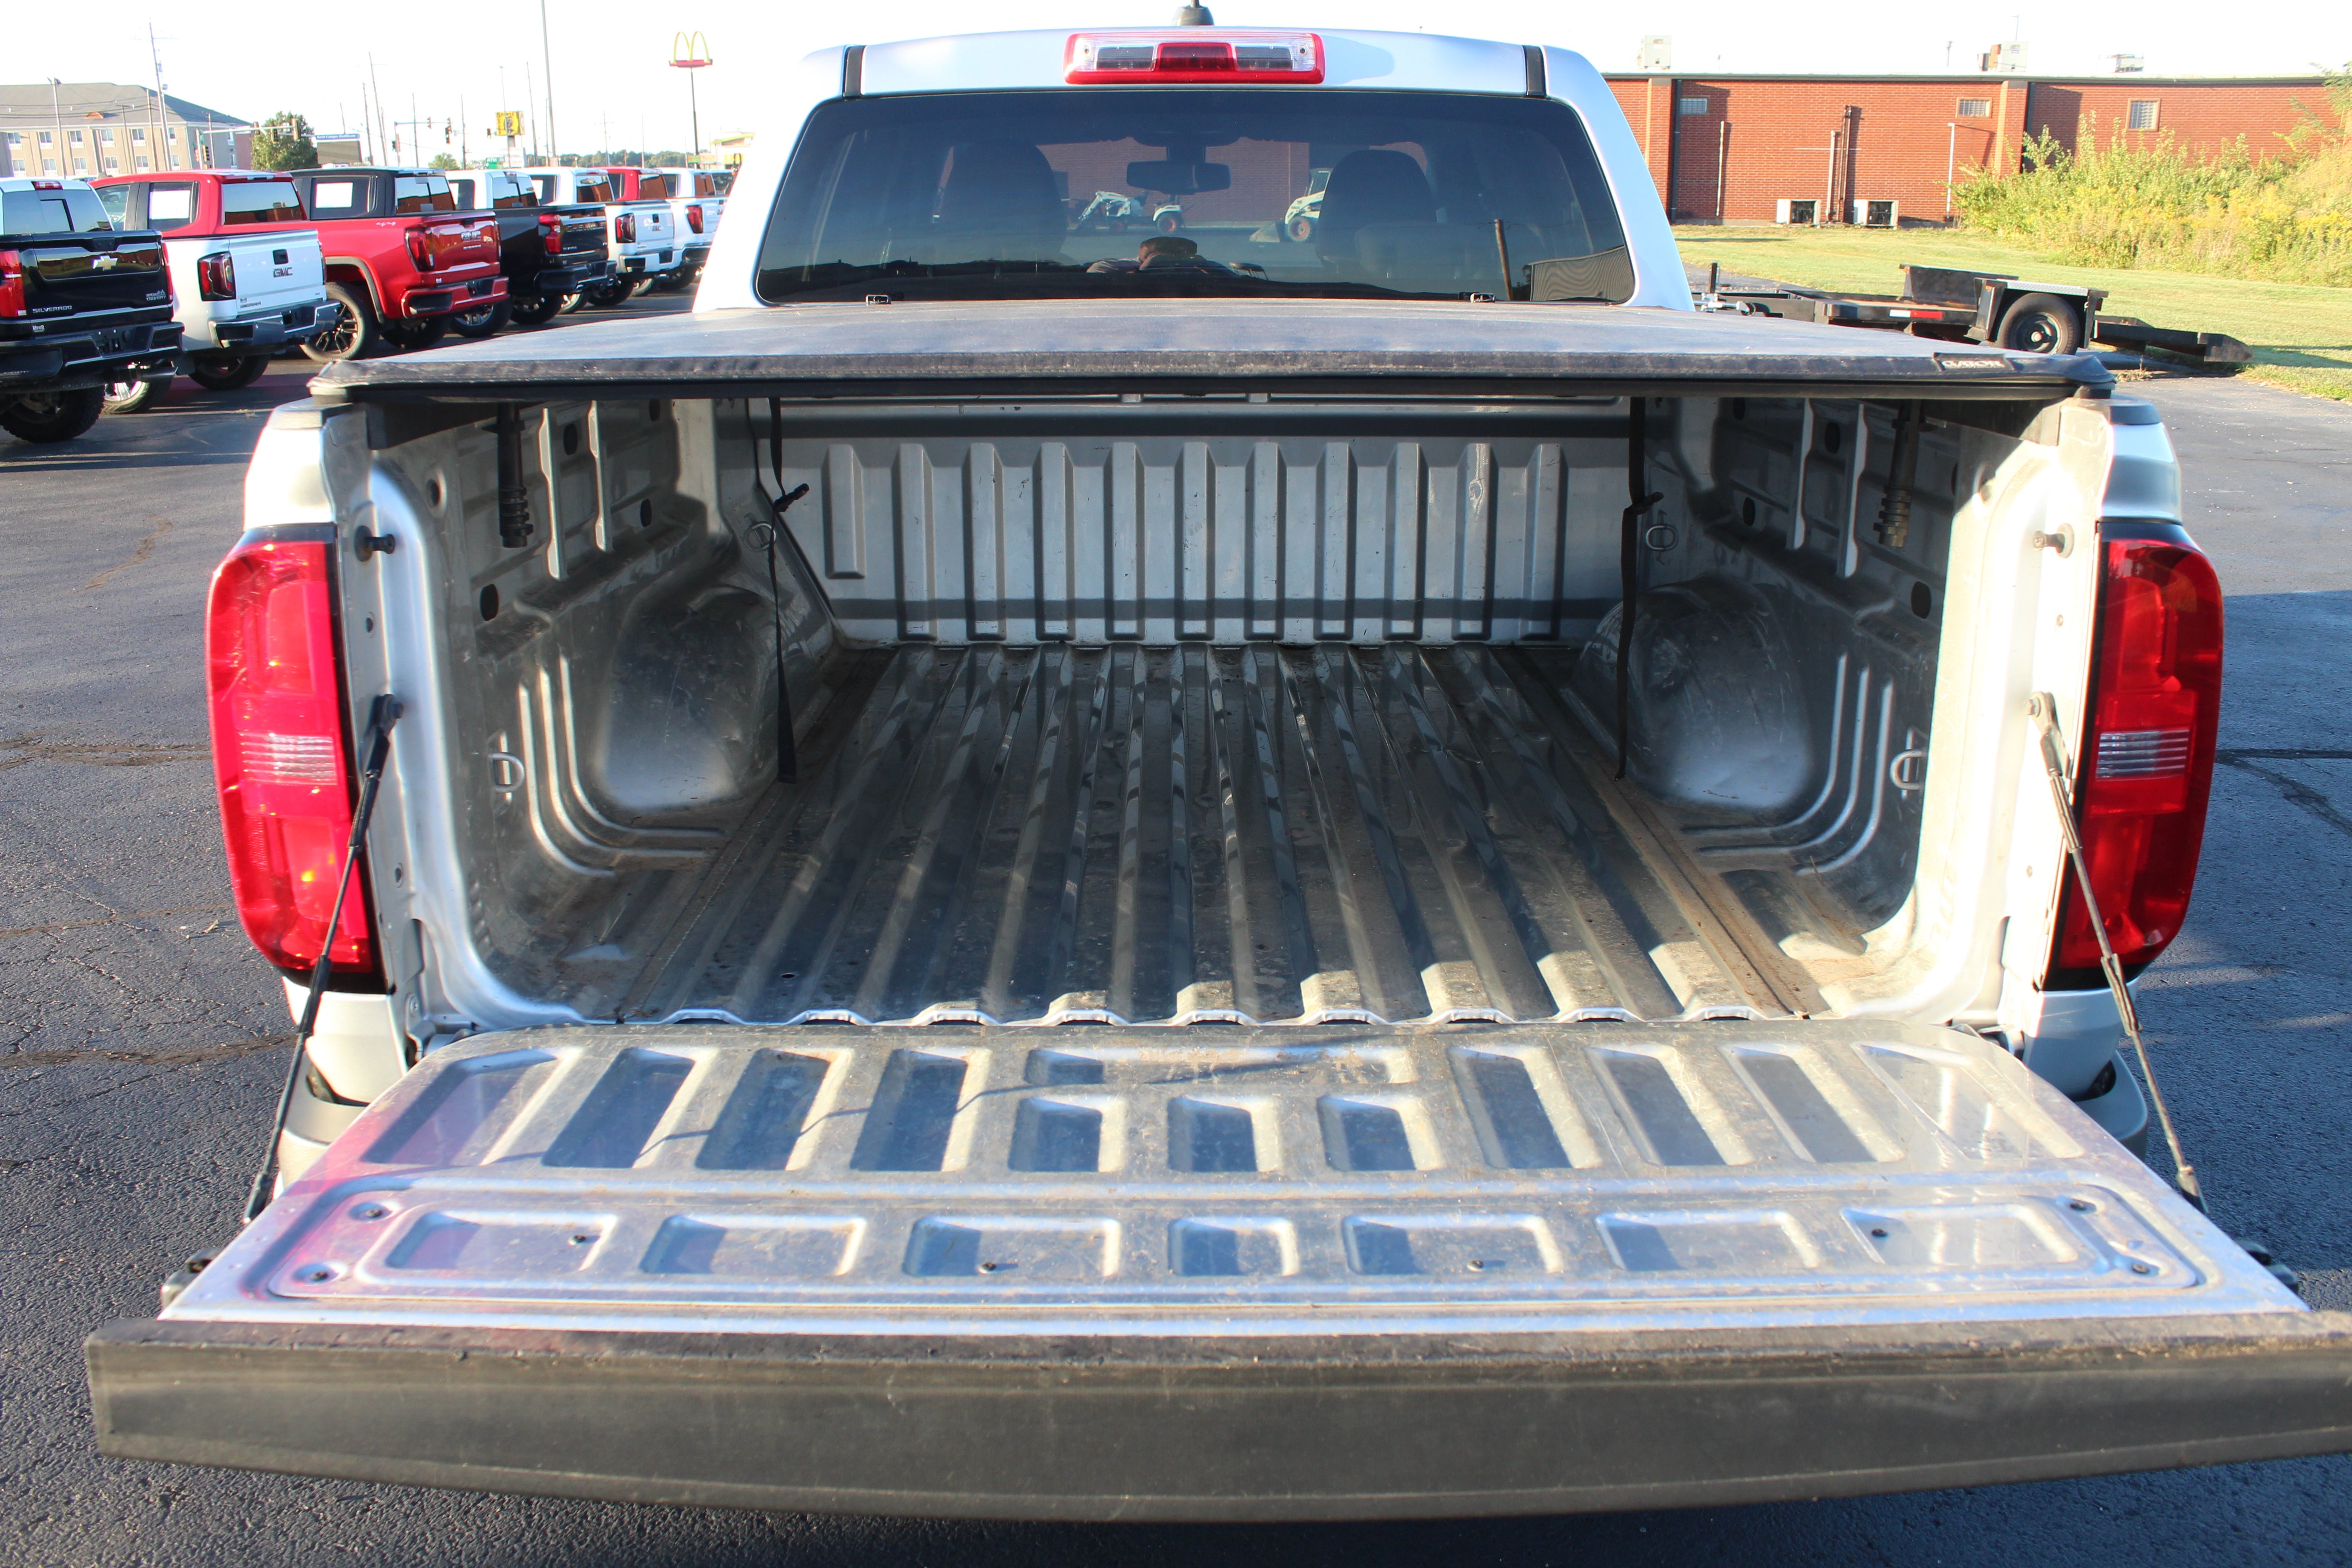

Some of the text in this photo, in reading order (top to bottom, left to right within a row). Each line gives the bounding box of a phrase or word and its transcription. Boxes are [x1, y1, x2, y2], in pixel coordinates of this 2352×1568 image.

[461, 230, 481, 240] GMC
[273, 267, 294, 278] GMC
[1941, 360, 2006, 369] GATOR
